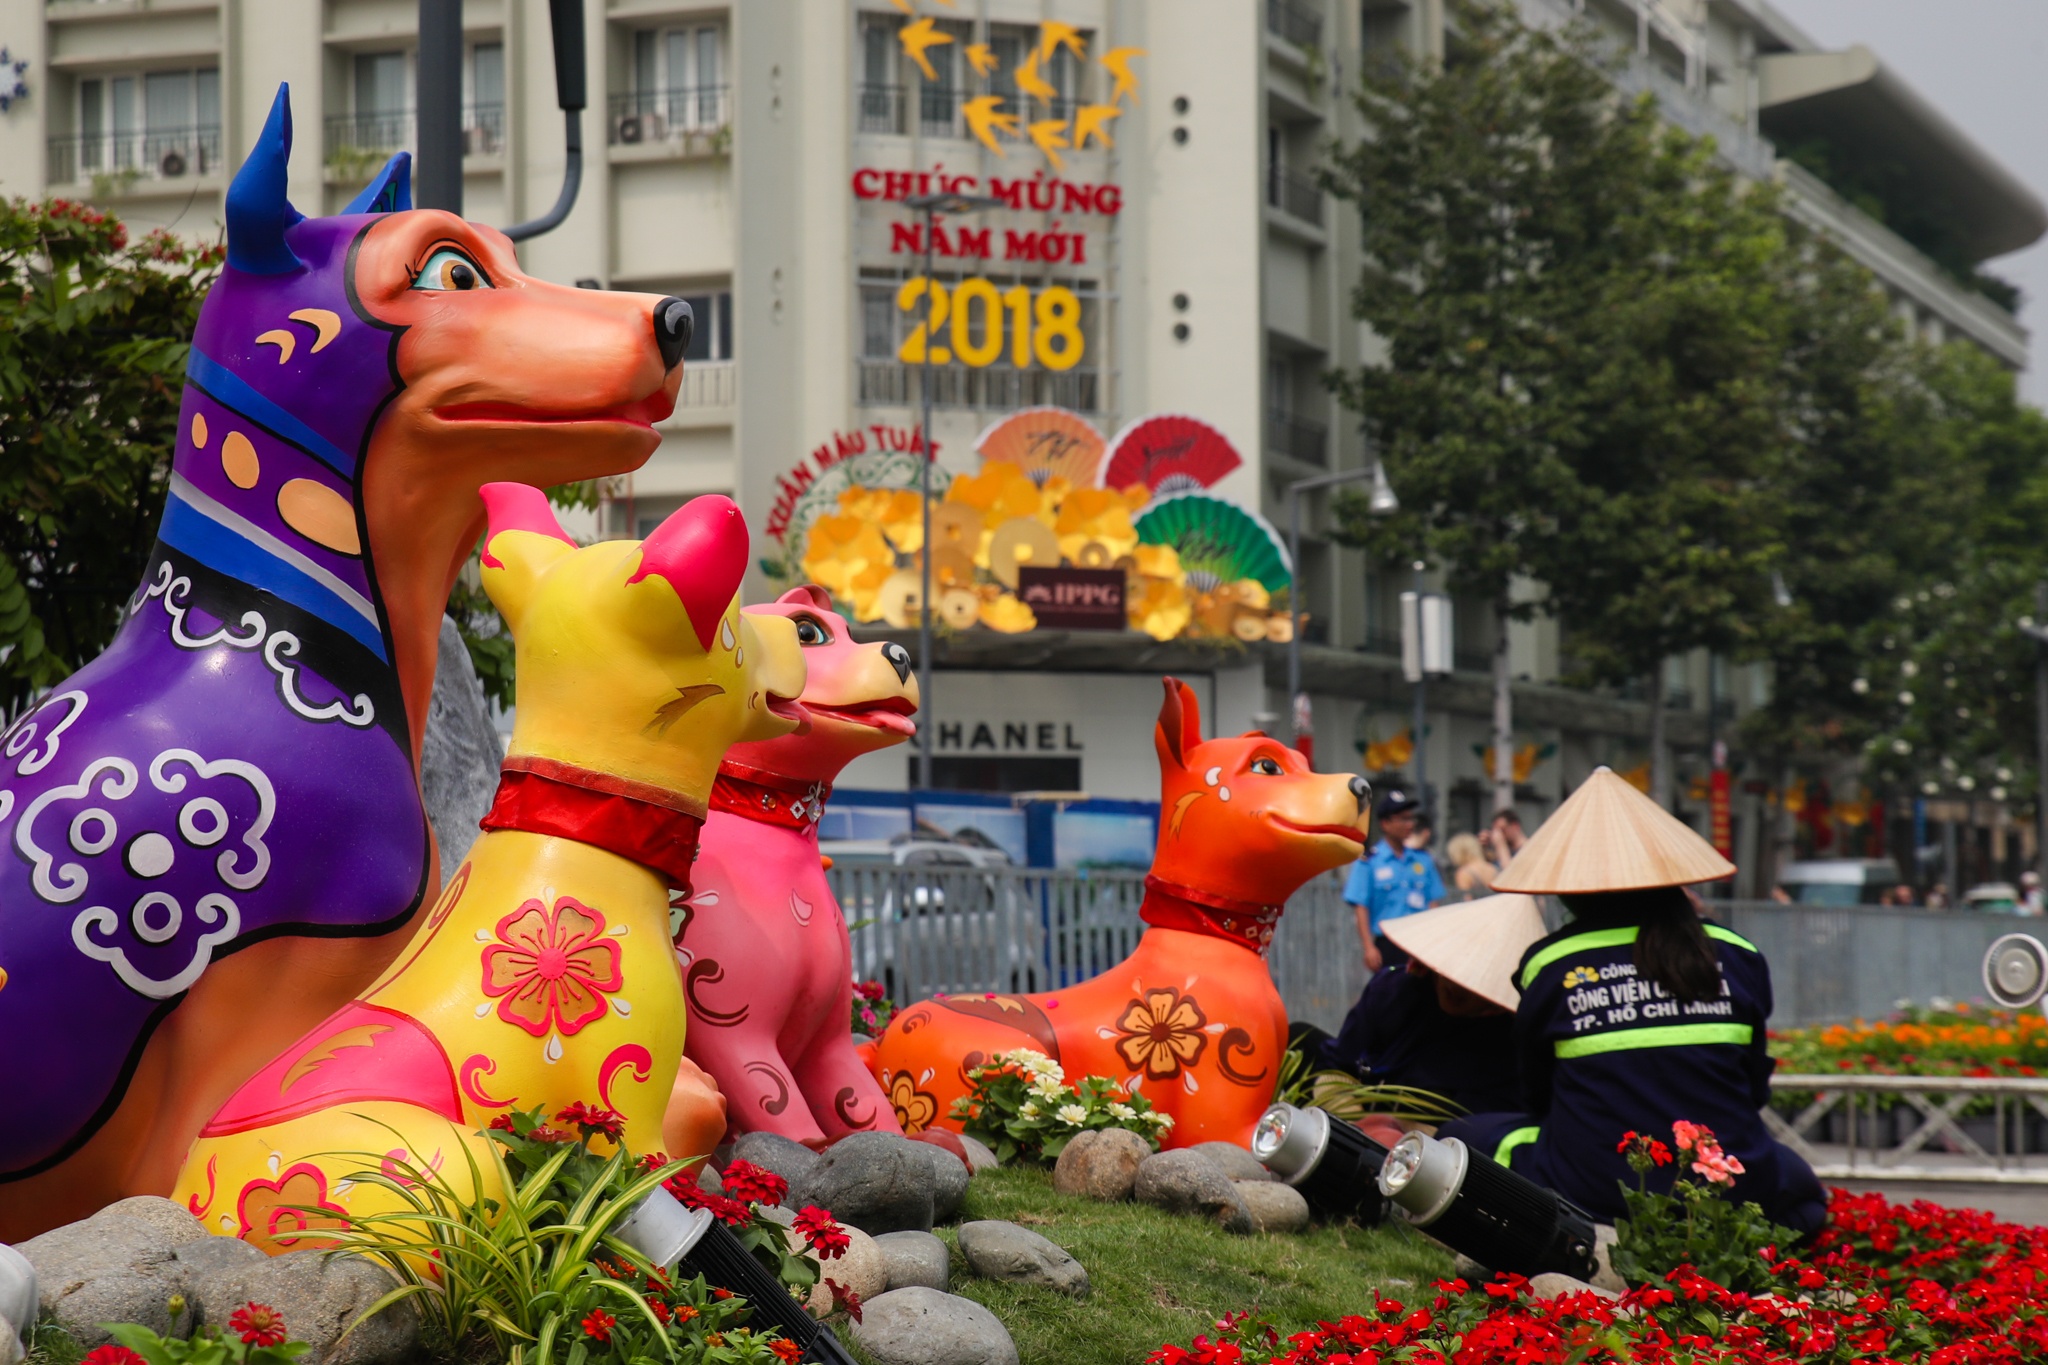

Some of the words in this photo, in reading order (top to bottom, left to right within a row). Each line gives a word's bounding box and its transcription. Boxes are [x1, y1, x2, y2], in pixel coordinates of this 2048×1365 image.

[852, 163, 978, 202] CHÚC
[890, 215, 993, 260] NĂM
[1003, 220, 1087, 270] MỚI
[897, 276, 1085, 371] 2018
[764, 460, 816, 546] XUÂN
[1053, 583, 1120, 605] IPPG
[1599, 962, 1638, 981] CÔNG
[1566, 987, 1611, 1015] CÔNG
[1610, 976, 1651, 1005] VIÊN
[1572, 1013, 1603, 1032] TP.
[1606, 1002, 1638, 1024] HỒ
[1641, 999, 1680, 1018] CHÍ
[1683, 1001, 1733, 1016] MINH
